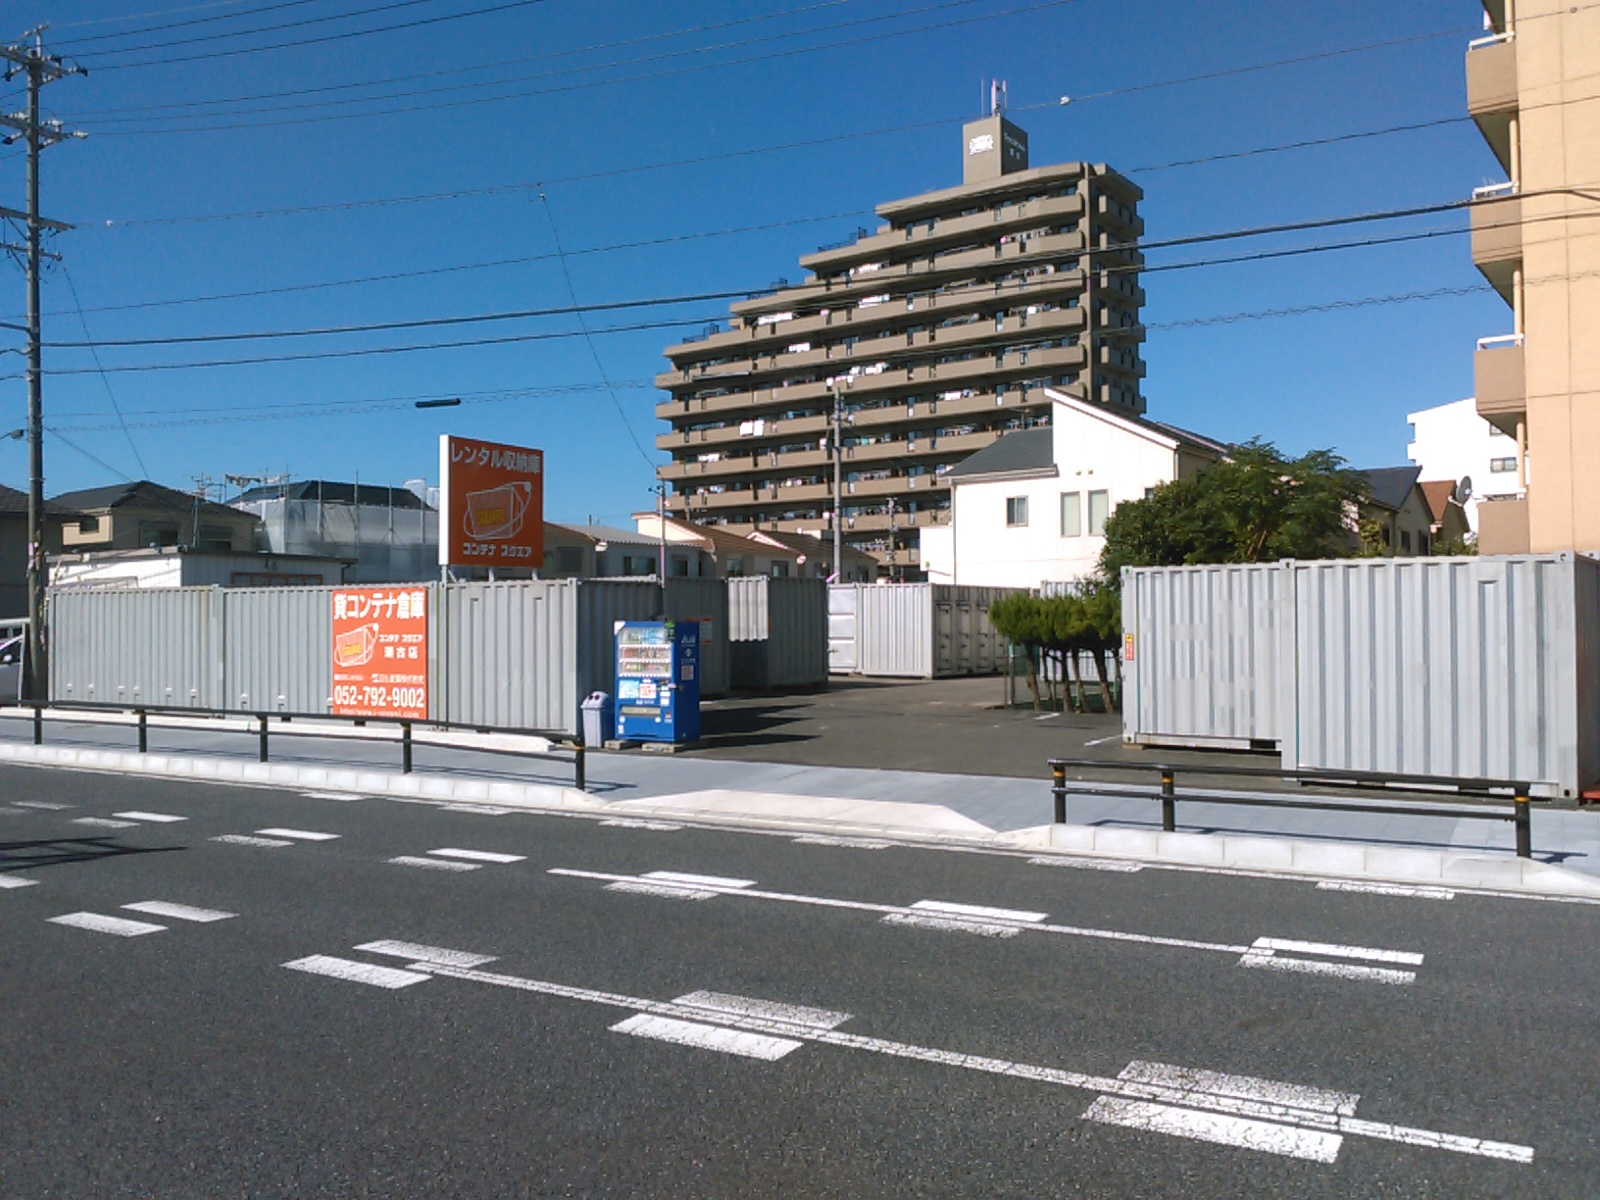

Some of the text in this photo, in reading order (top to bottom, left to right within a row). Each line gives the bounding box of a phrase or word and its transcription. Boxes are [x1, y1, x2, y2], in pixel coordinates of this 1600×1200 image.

[451, 442, 540, 474] レンタル収納庫
[463, 542, 531, 558] コンテナ スクエア
[333, 591, 425, 620] 貸コンテナ倉庫
[334, 684, 425, 708] 052-792-9002
